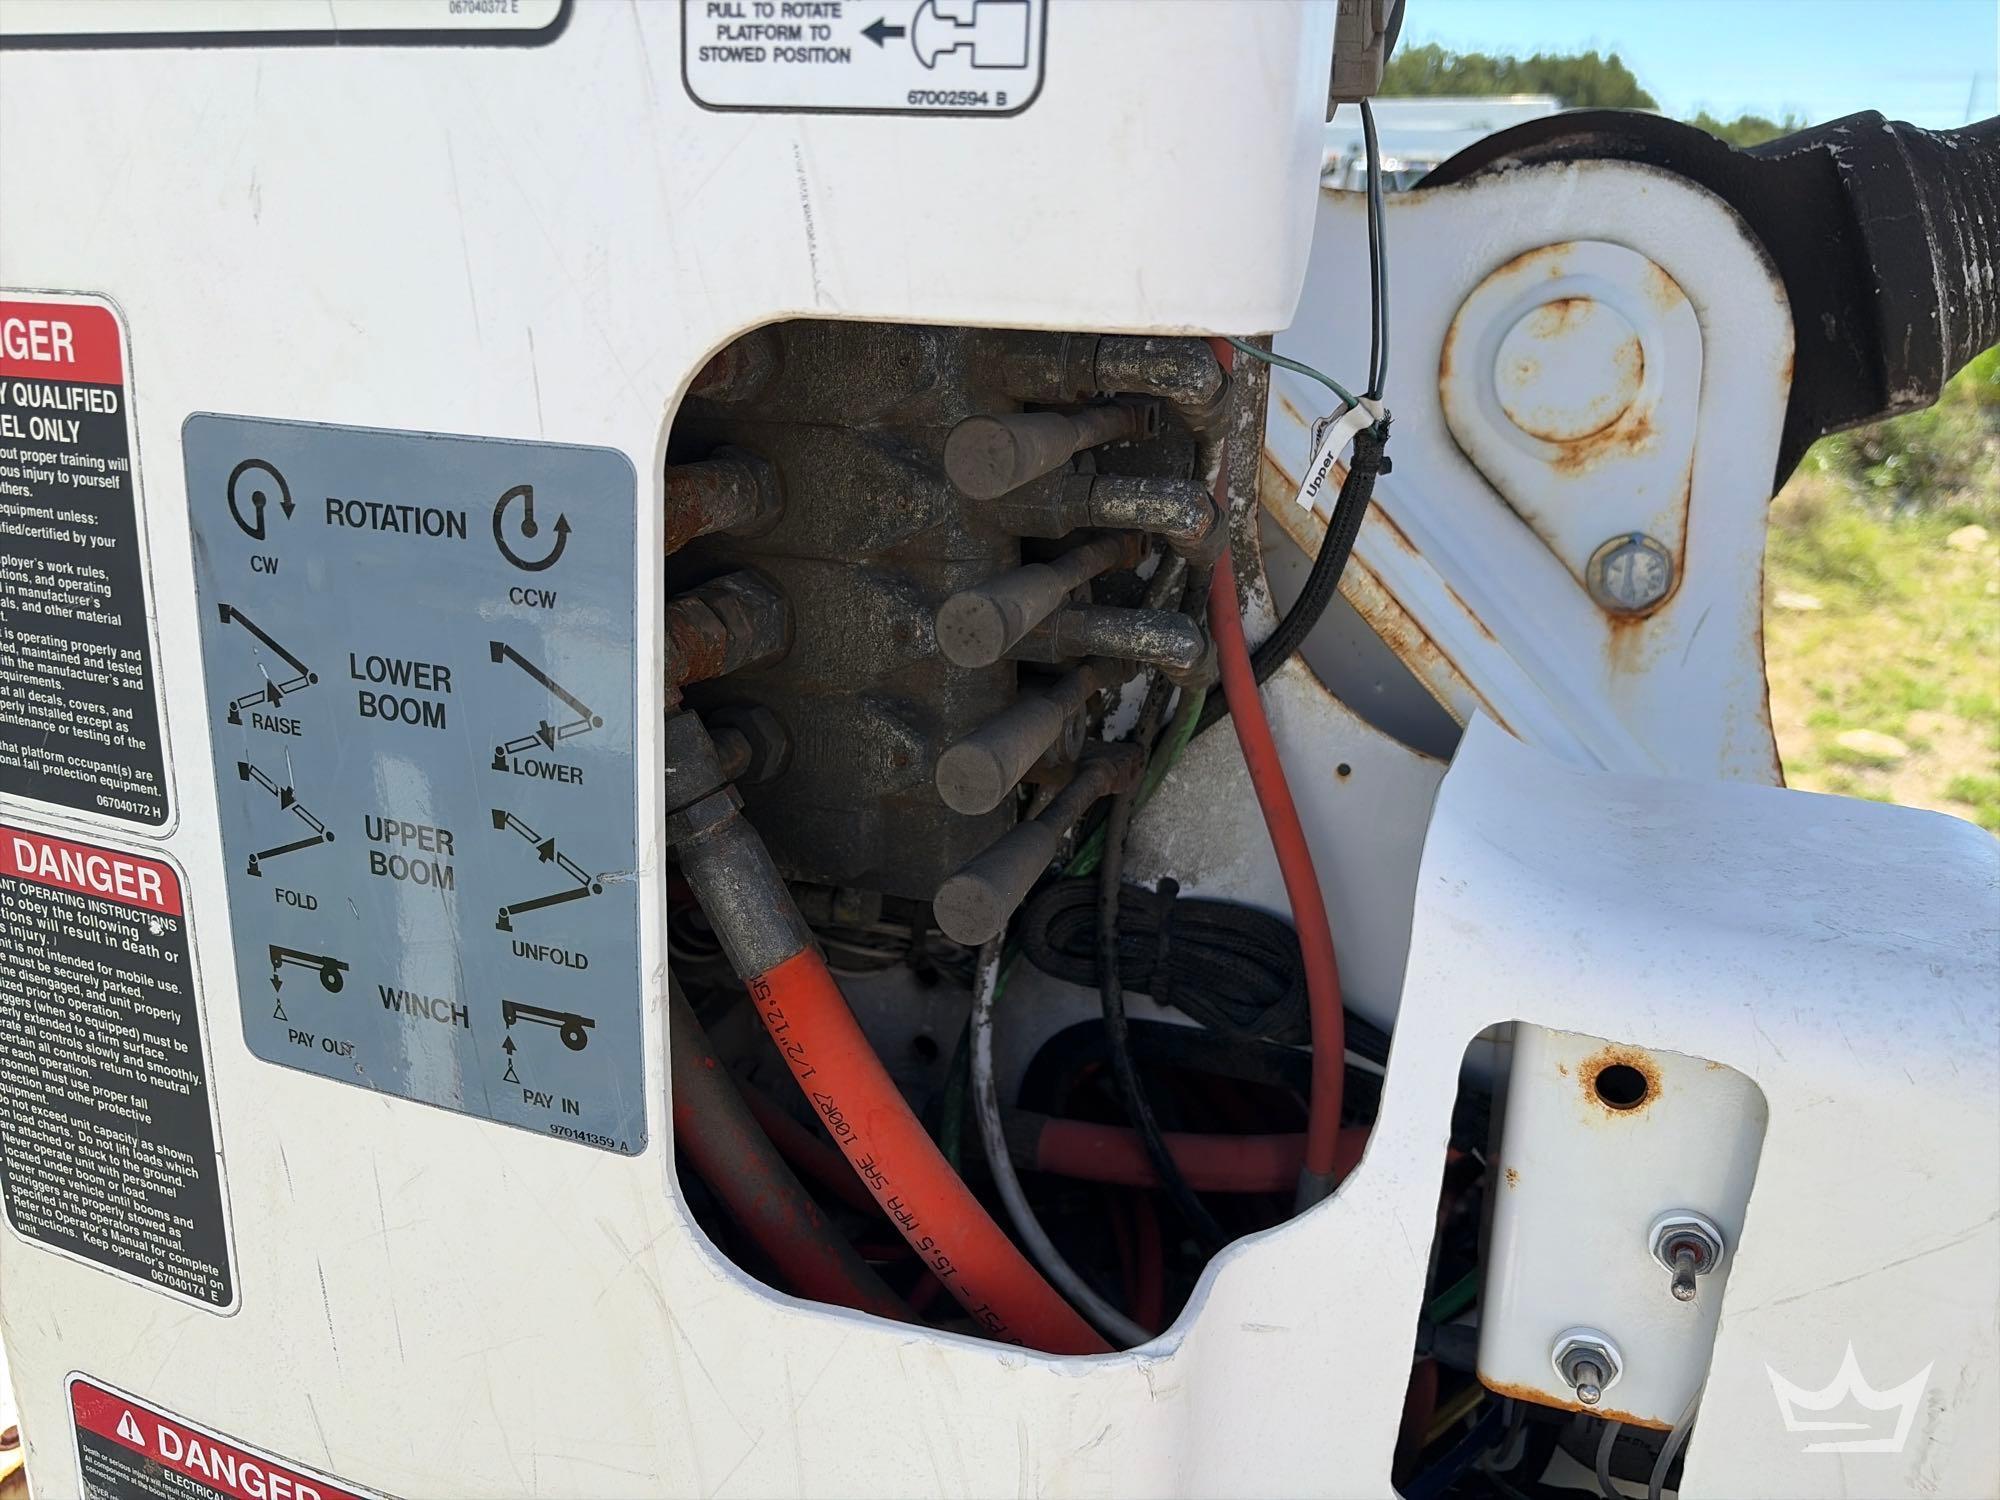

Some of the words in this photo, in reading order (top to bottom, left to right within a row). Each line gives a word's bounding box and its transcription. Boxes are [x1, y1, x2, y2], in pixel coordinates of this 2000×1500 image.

[449, 0, 508, 14] 067040372
[706, 2, 746, 18] PULL
[753, 2, 775, 18] TO
[781, 2, 842, 18] ROTATE
[716, 24, 802, 40] PLATFORM
[808, 25, 832, 41] TO
[699, 46, 766, 62] STOWED
[773, 47, 851, 64] POSITION
[908, 90, 989, 106] 67002594
[996, 91, 1008, 106] B
[0, 318, 76, 363] GER
[12, 383, 117, 413] QUALIFIED
[29, 417, 80, 444] ONLY
[19, 450, 57, 466] proper
[59, 452, 105, 472] training
[107, 457, 128, 471] will
[1306, 450, 1334, 498] Upper
[22, 465, 54, 485] injury
[56, 469, 69, 483] to
[71, 474, 120, 489] yourself
[56, 509, 98, 524] unless:
[325, 498, 467, 540] ROTATION
[72, 530, 86, 546] by
[89, 535, 116, 548] your
[46, 562, 74, 574] work
[76, 565, 108, 581] rules,
[250, 555, 279, 575] CW
[4, 582, 15, 594] in
[18, 586, 100, 608] manufacturer's
[34, 574, 55, 586] and
[57, 578, 111, 598] operating
[508, 586, 557, 610] CCW
[21, 601, 41, 613] and
[44, 604, 73, 618] other
[76, 610, 121, 626] material
[4, 626, 14, 639] is
[16, 631, 68, 651] operating
[70, 641, 117, 659] properly
[120, 649, 142, 661] and
[21, 642, 80, 665] maintained
[83, 653, 104, 669] and
[106, 657, 142, 675] tested
[16, 657, 34, 670] the
[37, 663, 119, 686] manufacturer's
[122, 678, 143, 690] and
[350, 652, 452, 694] LOWER
[12, 687, 25, 699] all
[28, 689, 66, 708] decals,
[68, 699, 109, 716] covers,
[112, 707, 133, 719] and
[27, 702, 73, 722] installed
[76, 714, 113, 731] except
[115, 722, 129, 733] as
[358, 690, 447, 730] BOOM
[58, 724, 69, 734] or
[72, 725, 110, 745] testing
[113, 734, 124, 745] of
[127, 736, 146, 750] the
[252, 712, 302, 736] RAISE
[20, 745, 65, 763] platform
[67, 756, 132, 779] occupant(s)
[134, 769, 153, 781] are
[22, 755, 40, 770] fall
[42, 764, 97, 783] protection
[99, 774, 161, 796] equipment.
[512, 756, 584, 786] LOWER
[96, 794, 150, 816] 067040172
[152, 806, 161, 818] H
[364, 814, 455, 856] UPPER
[13, 837, 164, 905] DANGER
[369, 850, 456, 892] BOOM
[19, 882, 85, 909] OPERATING
[87, 899, 177, 932] INSTRUCTIONS
[274, 887, 318, 912] FOLD
[0, 892, 14, 906] to
[18, 898, 48, 918] obey
[52, 905, 73, 922] the
[76, 911, 139, 941] following
[9, 922, 49, 946] injury.
[36, 914, 59, 932] will
[62, 925, 101, 944] result
[104, 932, 118, 948] in
[122, 937, 160, 958] death
[164, 951, 178, 963] or
[14, 939, 24, 952] is
[26, 944, 45, 958] not
[46, 948, 94, 971] intended
[96, 961, 112, 975] for
[115, 969, 154, 987] mobile
[157, 980, 182, 994] use.
[512, 938, 588, 970] UNFOLD
[8, 954, 35, 969] must
[37, 959, 50, 973] be
[53, 966, 99, 989] securely
[102, 979, 144, 1000] parked,
[377, 984, 470, 1028] WINCH
[288, 1028, 315, 1048] PAY
[522, 1088, 554, 1110] PAY
[562, 1097, 580, 1116] IN
[812, 1092, 858, 1146] 100R7
[550, 1124, 615, 1148] 970141359
[620, 1141, 629, 1152] A
[855, 1152, 890, 1190] SAE
[8, 1171, 60, 1196] outriggers
[62, 1190, 79, 1202] are
[81, 1196, 124, 1220] properly
[127, 1212, 166, 1232] stowed
[168, 1226, 181, 1238] as
[10, 1179, 56, 1206] specified
[58, 1198, 68, 1211] in
[70, 1203, 87, 1217] the
[89, 1209, 140, 1236] operators
[142, 1230, 185, 1252] manual.
[887, 1196, 920, 1232] MPA
[13, 1194, 39, 1212] Refer
[41, 1205, 52, 1217] to
[54, 1209, 108, 1237] Operator's
[110, 1228, 148, 1251] Manual
[150, 1243, 166, 1257] for
[168, 1252, 219, 1276] complete
[16, 1216, 40, 1236] unit.
[15, 1206, 78, 1238] instructions.
[82, 1231, 109, 1250] Keep
[111, 1244, 164, 1269] operator's
[167, 1259, 206, 1285] manual
[209, 1279, 224, 1290] on
[151, 1268, 205, 1297] 067040174
[210, 1290, 219, 1302] E
[973, 1304, 1008, 1334] PSI
